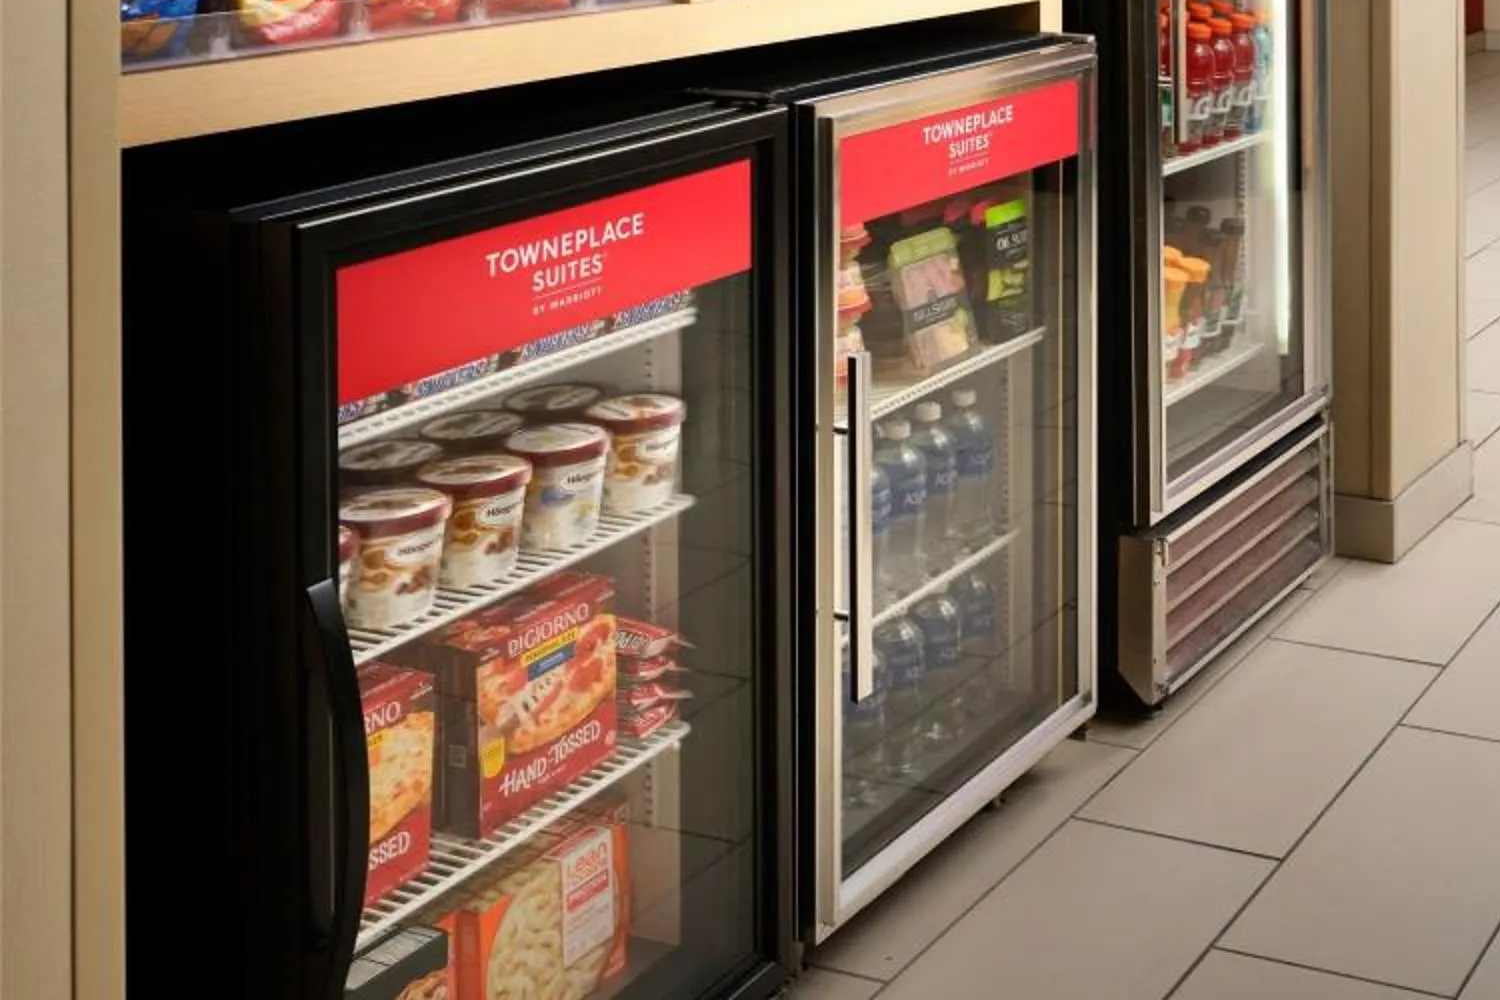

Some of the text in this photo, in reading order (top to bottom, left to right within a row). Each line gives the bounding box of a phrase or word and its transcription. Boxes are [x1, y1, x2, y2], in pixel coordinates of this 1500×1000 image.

[922, 104, 1014, 145] TOWNEPLACE
[948, 134, 989, 159] SUITES
[485, 212, 645, 277] TOWNEPLACE
[532, 253, 603, 292] SUITES
[532, 303, 545, 316] BY
[549, 285, 602, 310] MARRIOTT
[508, 603, 589, 658] DIGIORNO
